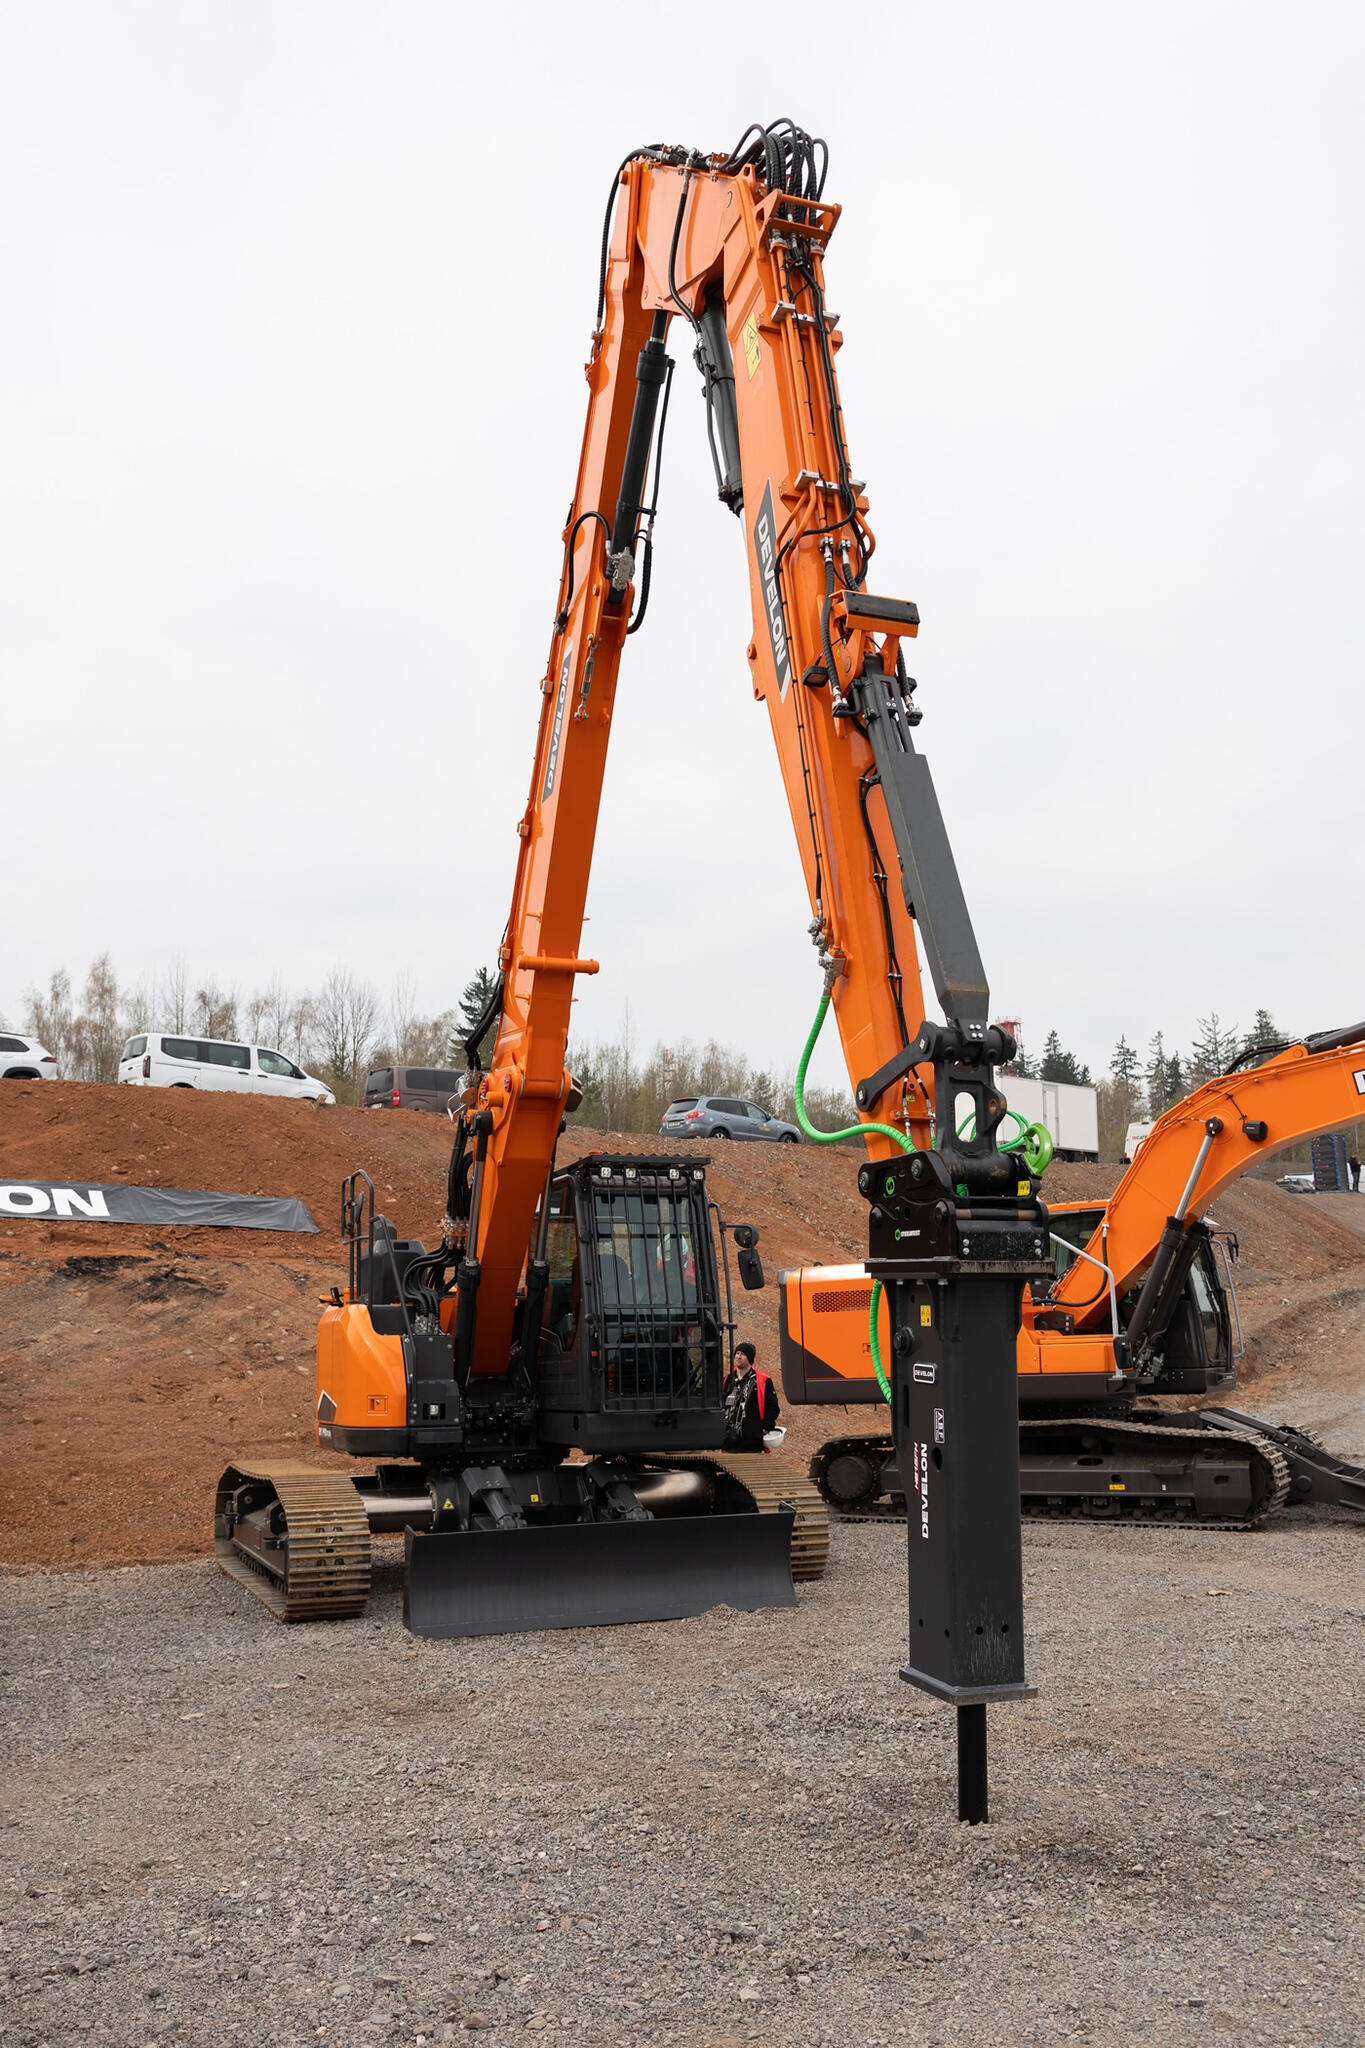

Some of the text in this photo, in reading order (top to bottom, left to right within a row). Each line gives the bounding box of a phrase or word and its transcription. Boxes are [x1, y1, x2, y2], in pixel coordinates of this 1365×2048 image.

[757, 513, 787, 666] DEVELON
[547, 667, 569, 790] DEVELON
[0, 1185, 110, 1216] ON
[914, 1369, 933, 1377] DEVELON
[920, 1442, 929, 1539] DEVELON
